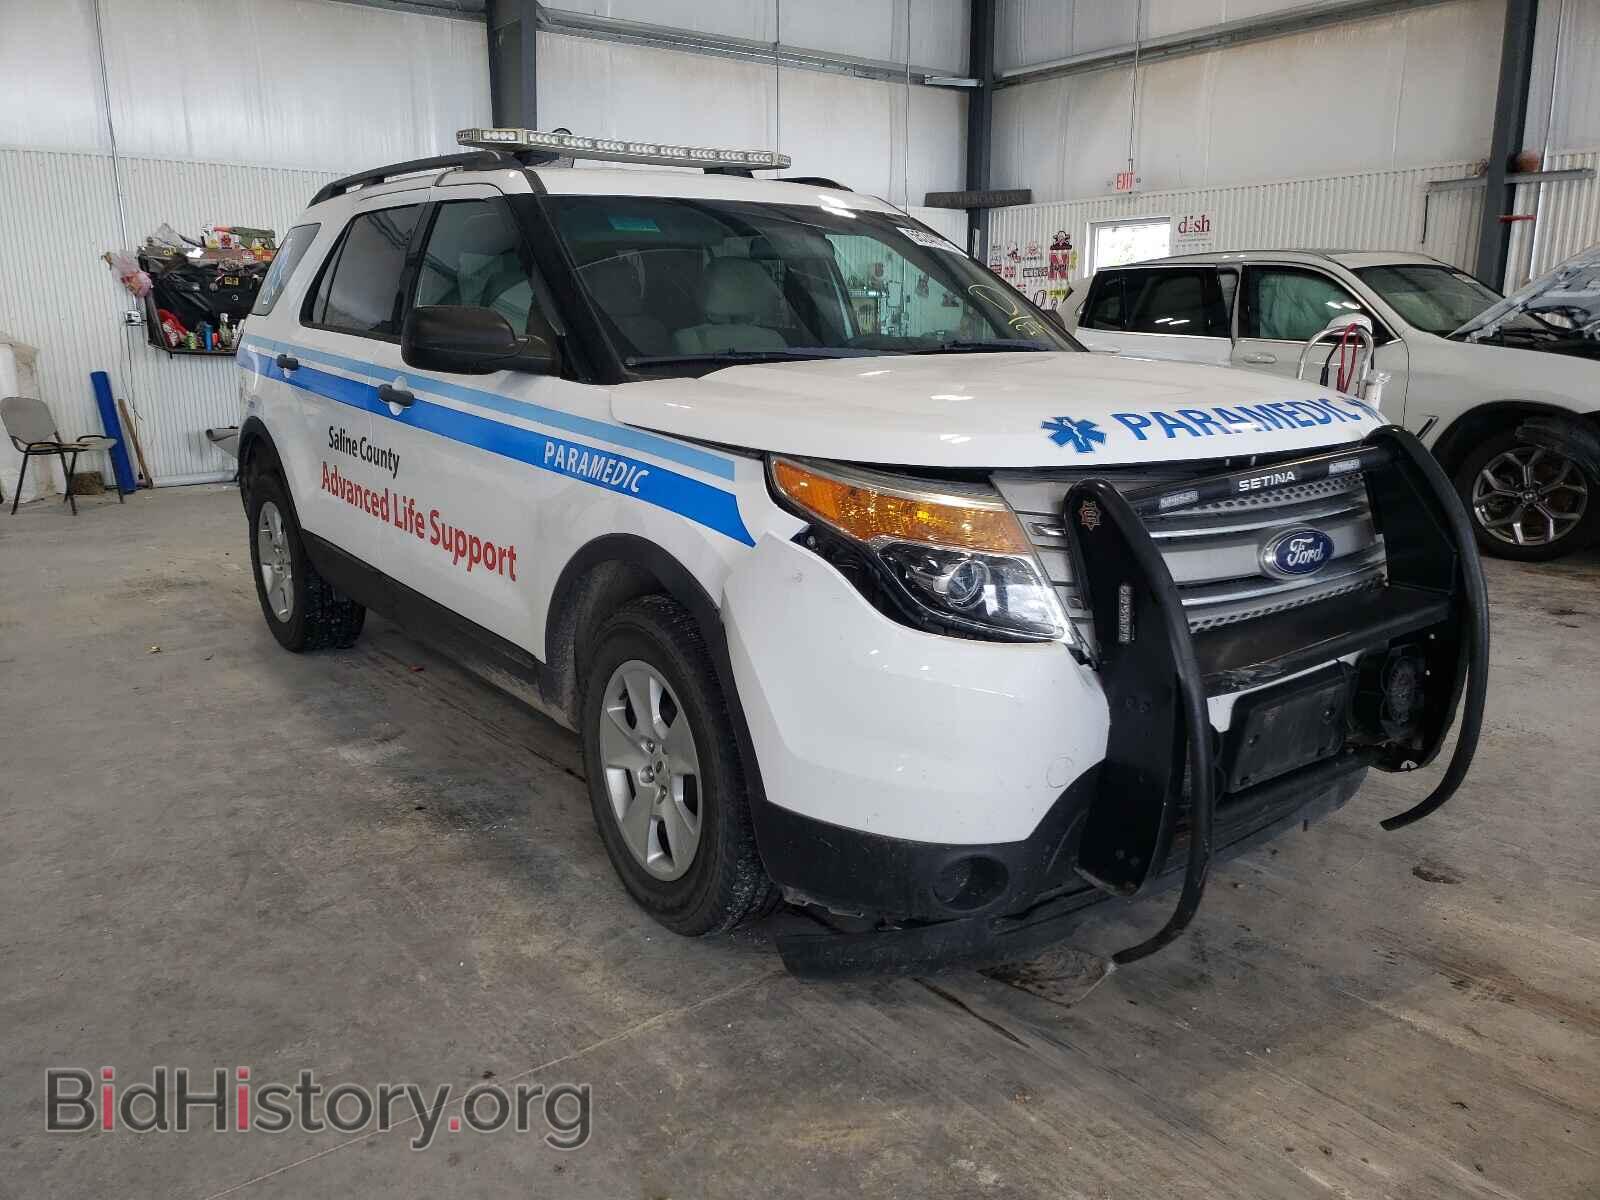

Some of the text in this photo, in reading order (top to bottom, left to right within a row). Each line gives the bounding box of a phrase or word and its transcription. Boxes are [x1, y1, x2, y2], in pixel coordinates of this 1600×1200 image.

[1116, 172, 1135, 191] EXIT
[1178, 214, 1210, 233] dish
[1112, 398, 1361, 441] PARAMEDIC
[328, 425, 400, 479] Saline County
[543, 440, 650, 494] PARAMEDIC
[1237, 470, 1296, 492] SETINA
[321, 461, 518, 582] Advanced Life Support
[1287, 535, 1325, 567] Ford
